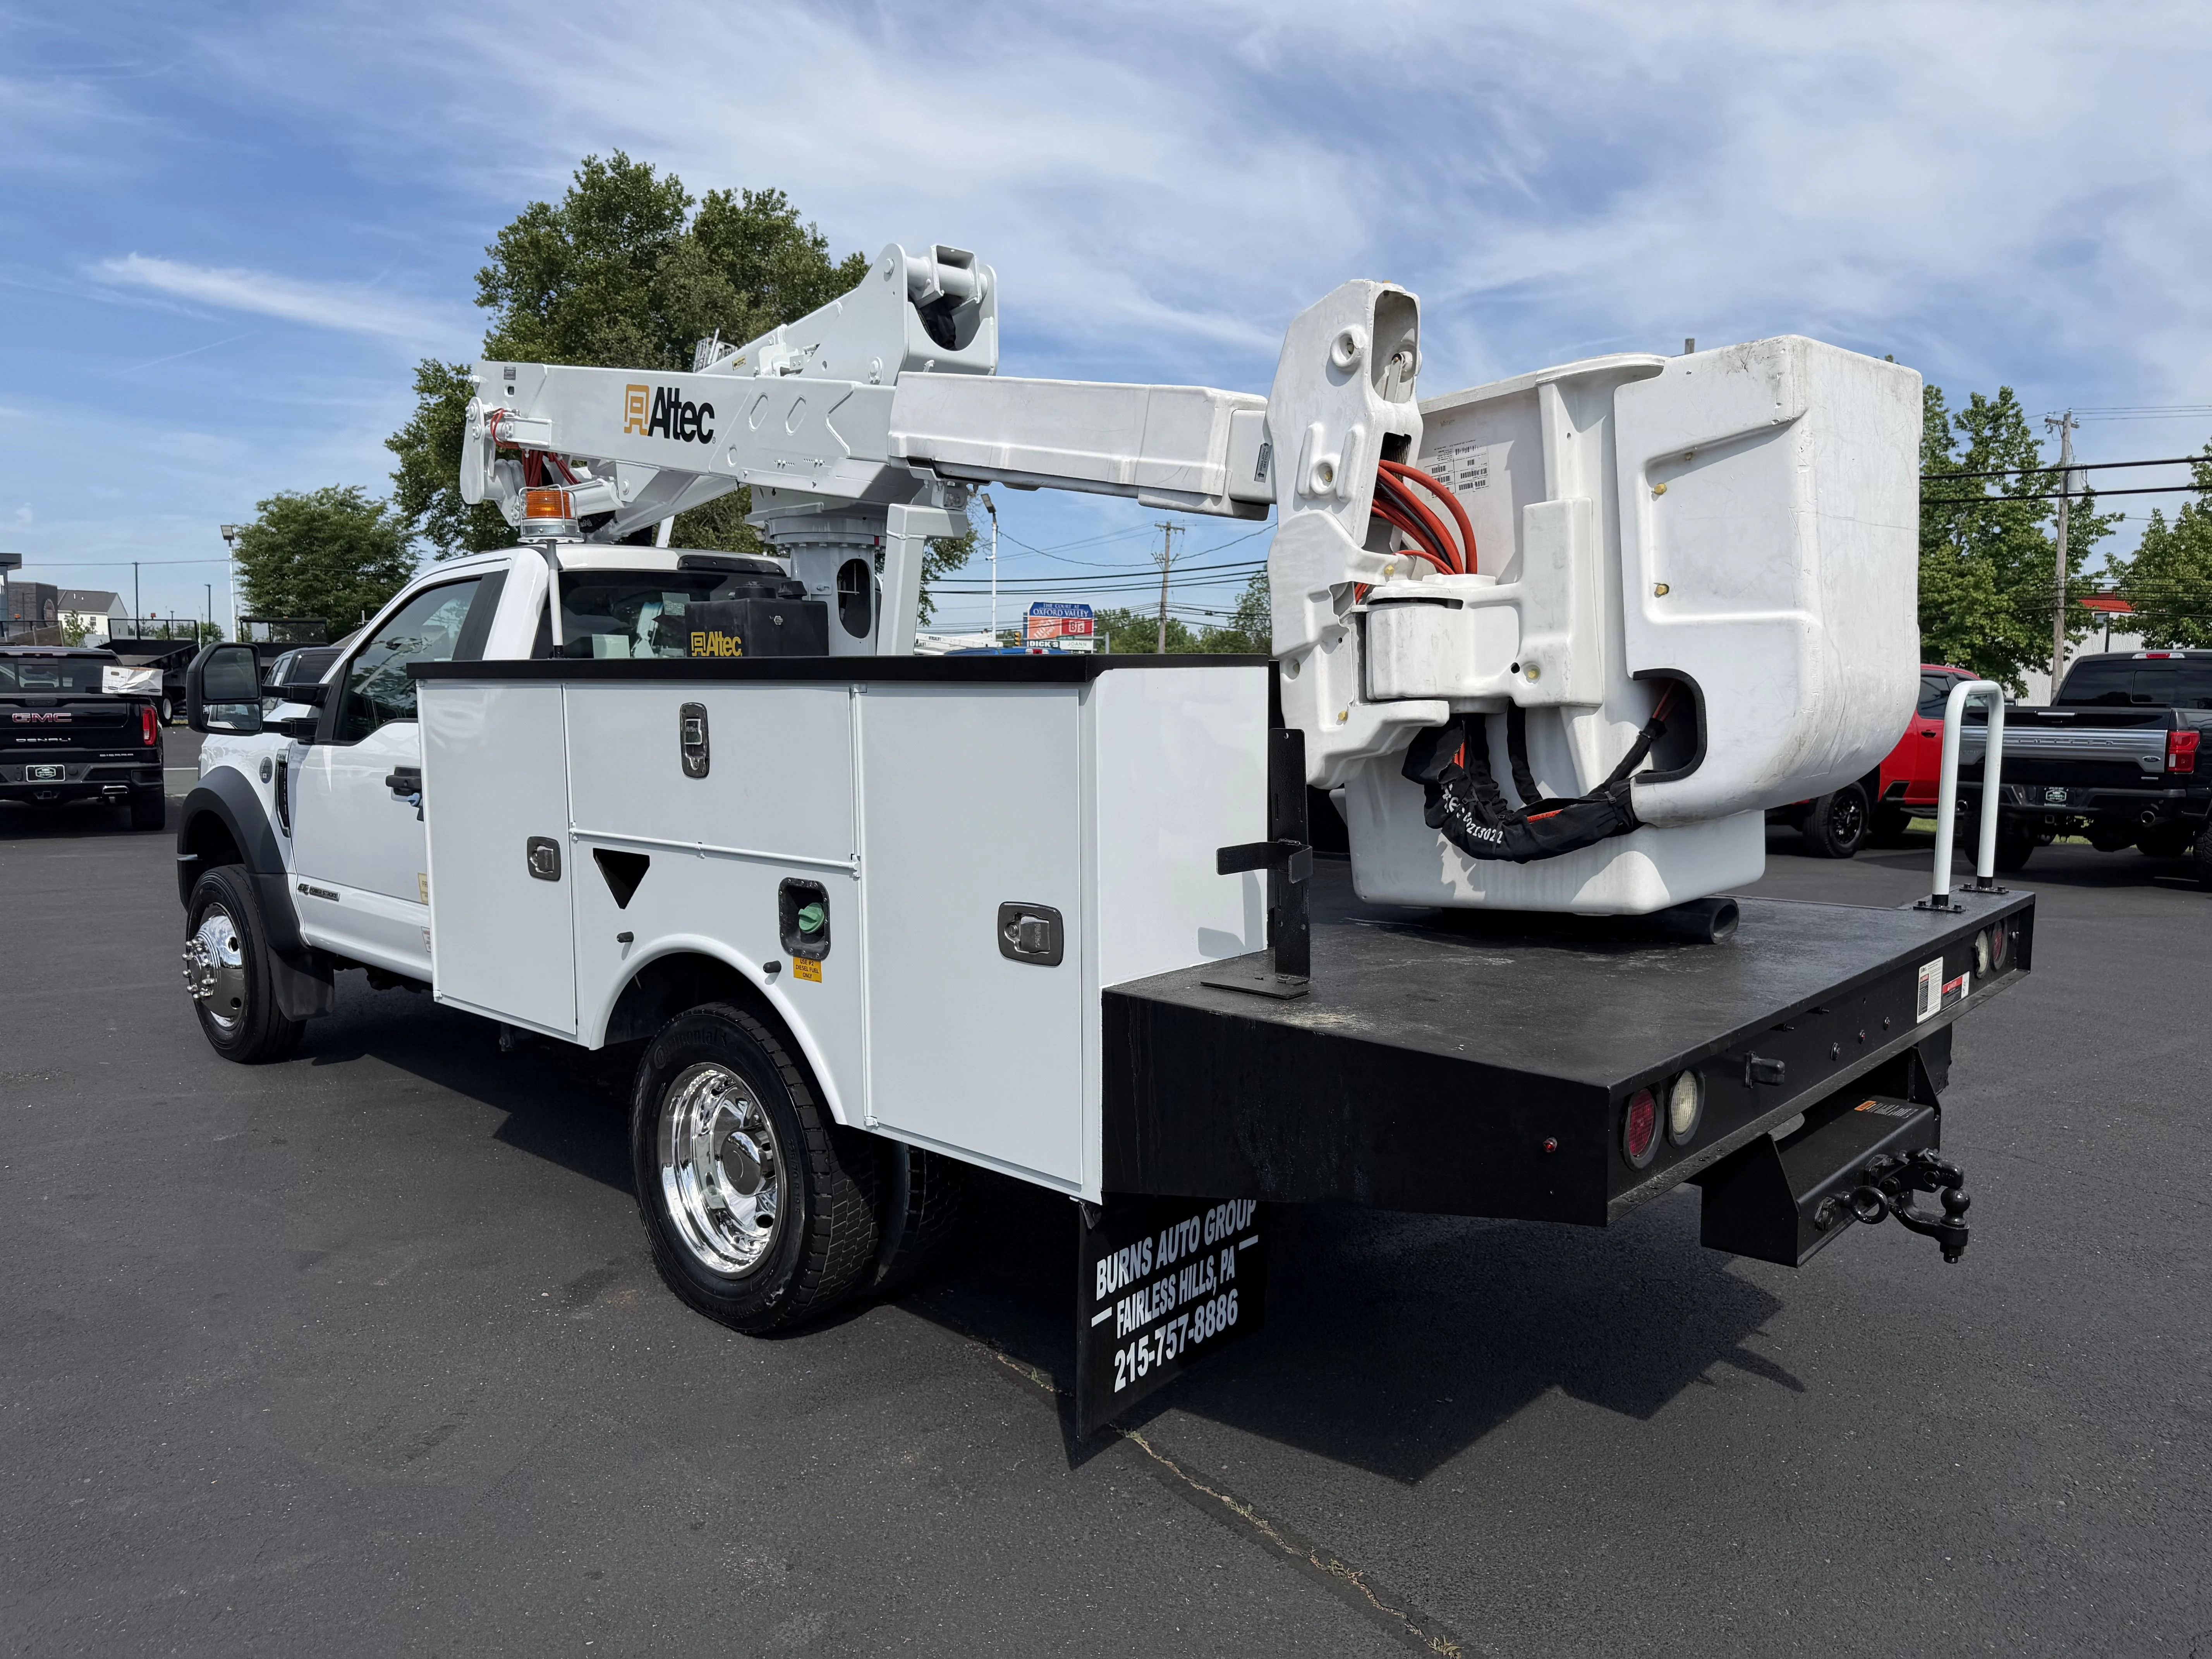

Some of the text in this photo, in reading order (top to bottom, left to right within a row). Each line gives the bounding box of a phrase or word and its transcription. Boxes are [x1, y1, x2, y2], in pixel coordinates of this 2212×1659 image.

[648, 386, 715, 444] Altec
[706, 631, 742, 656] Altec
[12, 713, 72, 723] GMC
[1097, 1199, 1256, 1300] BURNS AUTO GROUP
[1117, 1245, 1235, 1339] FAIRLESS HILLS, PA
[1115, 1289, 1238, 1393] 215-757-8886
